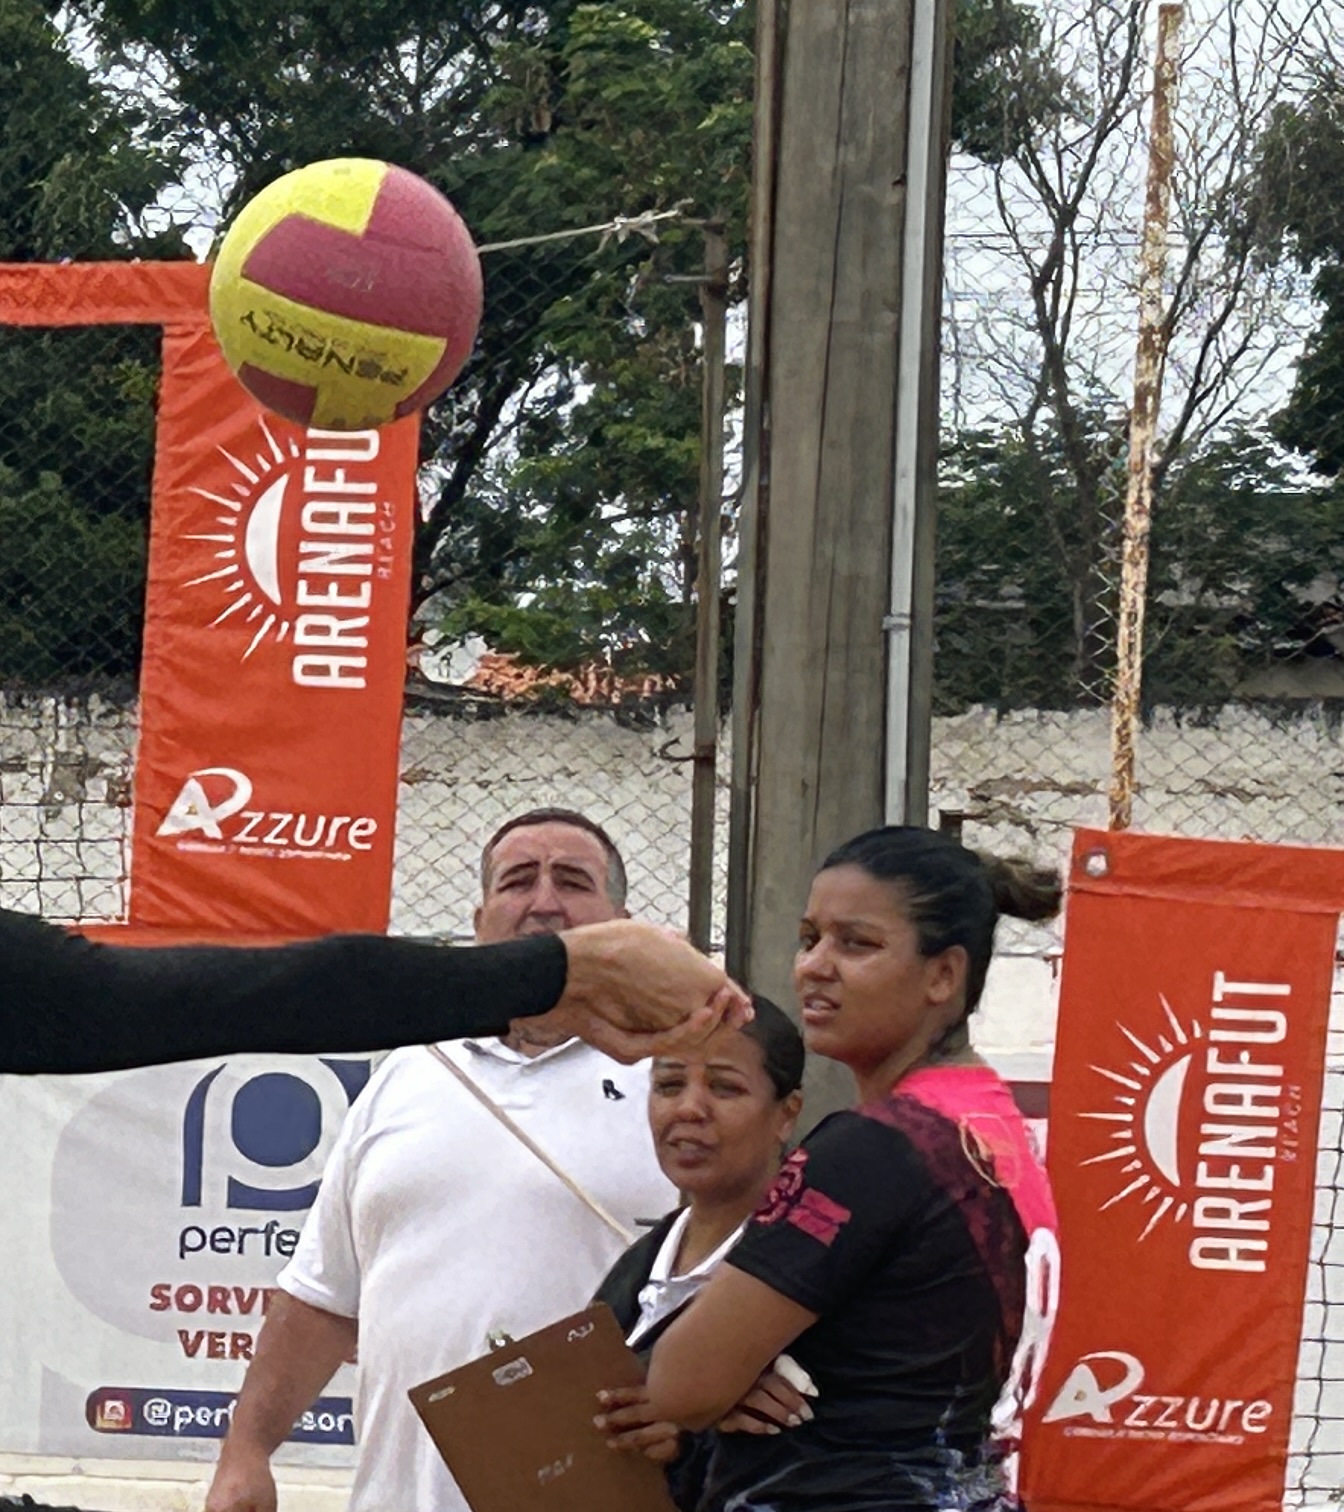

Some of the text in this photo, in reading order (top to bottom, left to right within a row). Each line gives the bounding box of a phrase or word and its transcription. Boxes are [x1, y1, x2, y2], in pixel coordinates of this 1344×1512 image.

[239, 310, 409, 387] PENALTY
[292, 427, 381, 690] ARENAFU
[155, 766, 379, 850] Azzure
[1188, 970, 1292, 1273] ARENAFUT
[1041, 1350, 1274, 1434] Azzure
